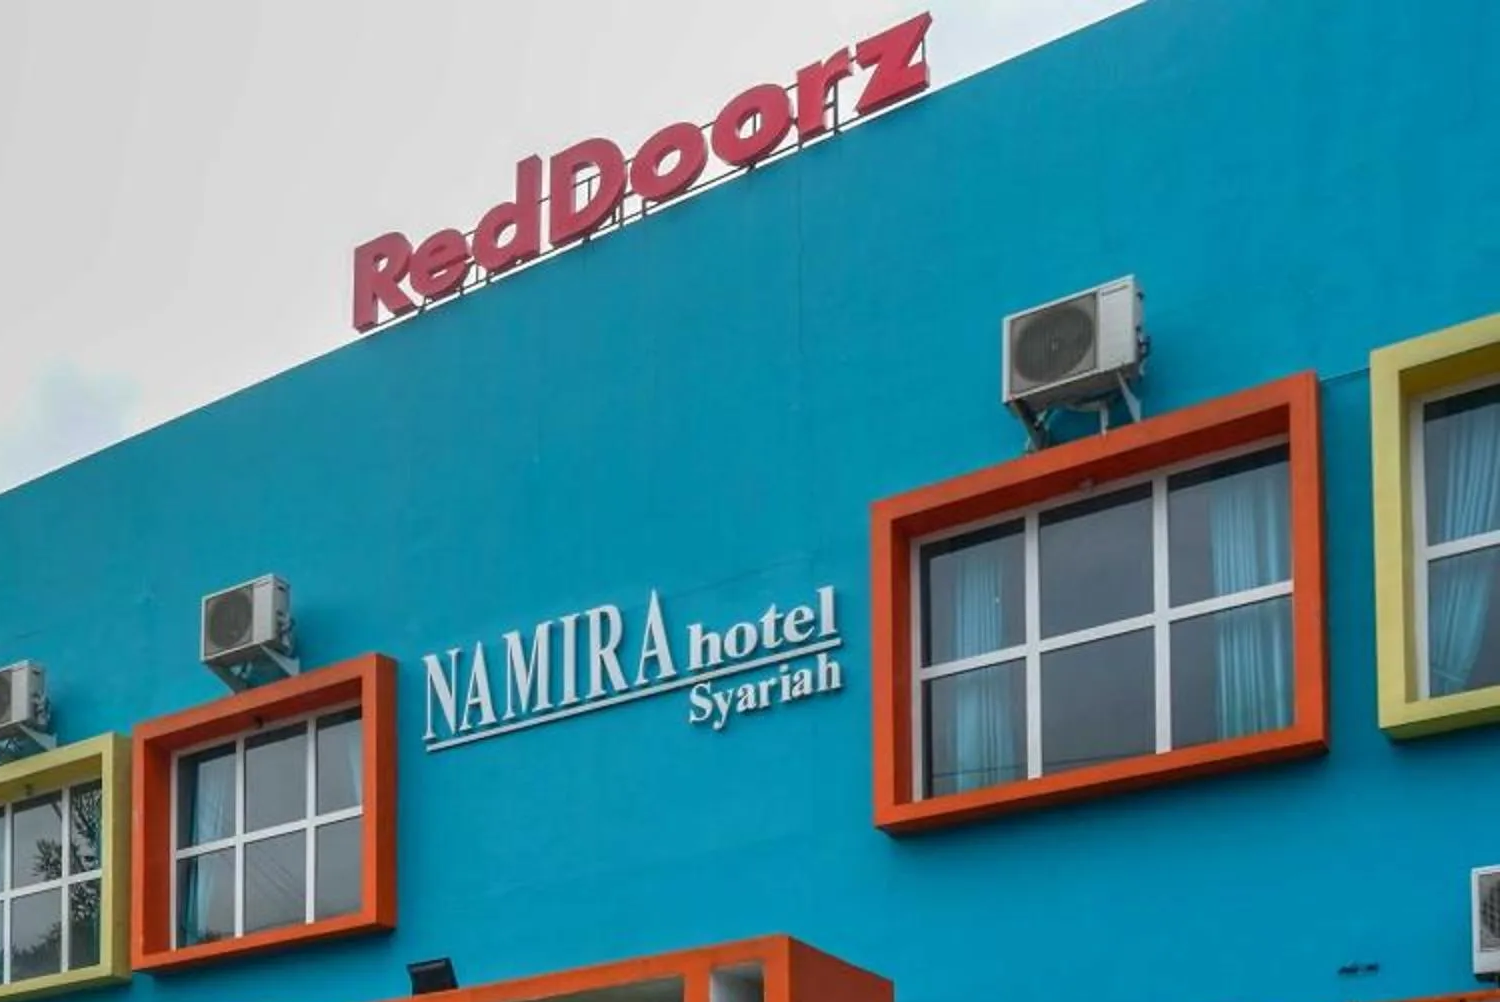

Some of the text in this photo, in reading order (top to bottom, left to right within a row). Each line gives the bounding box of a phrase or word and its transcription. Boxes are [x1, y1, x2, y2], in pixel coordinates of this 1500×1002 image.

[352, 10, 932, 334] RedDoorz
[422, 585, 839, 741] NAMIRA hotel
[688, 653, 842, 731] Syariah
